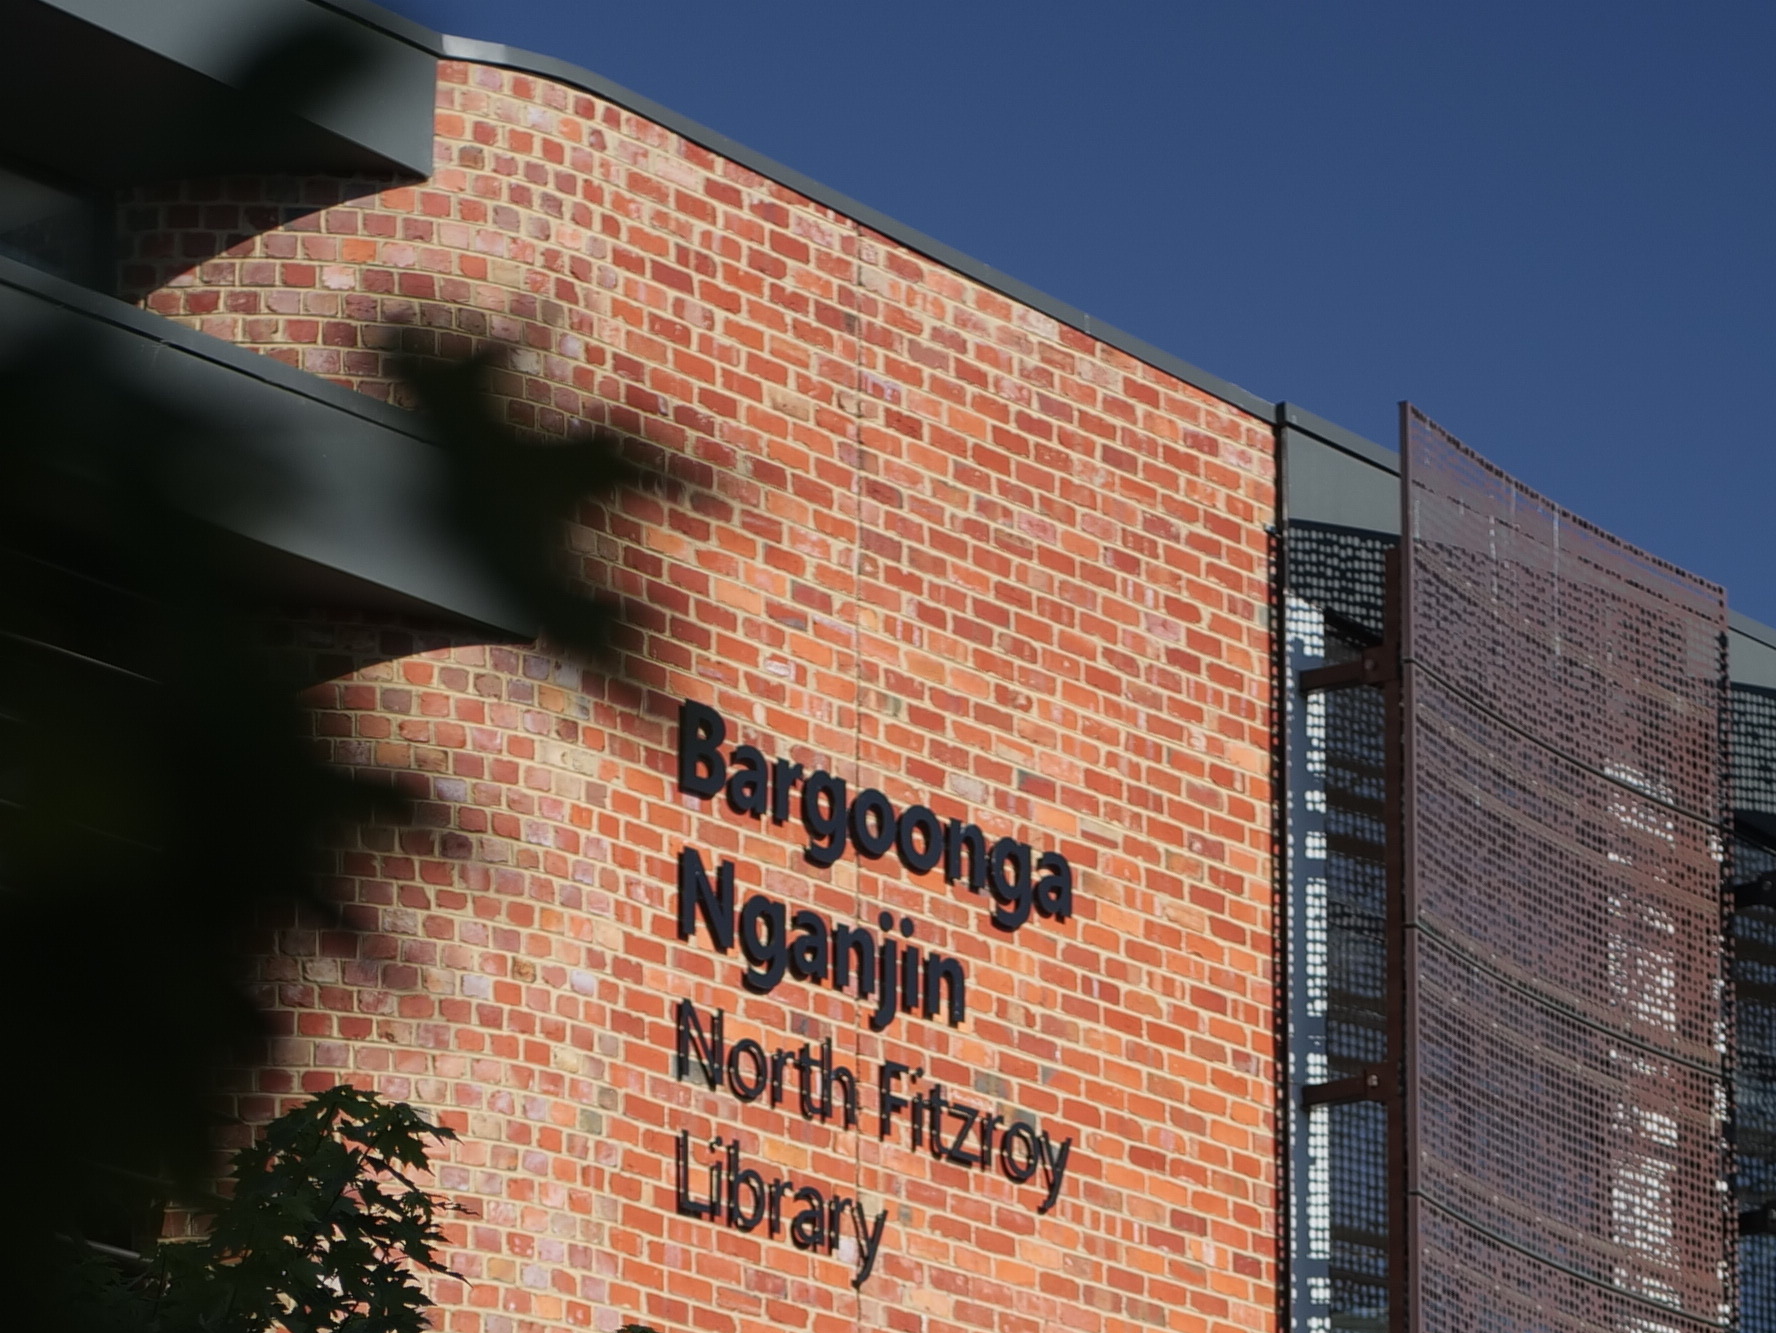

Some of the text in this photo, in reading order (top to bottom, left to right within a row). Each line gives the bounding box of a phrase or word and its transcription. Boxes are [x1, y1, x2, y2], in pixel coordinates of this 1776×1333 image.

[677, 699, 1074, 931] Bargoonga
[677, 847, 967, 1031] Nganjin
[677, 998, 1073, 1214] North Fitzroy
[676, 1129, 888, 1288] Library
